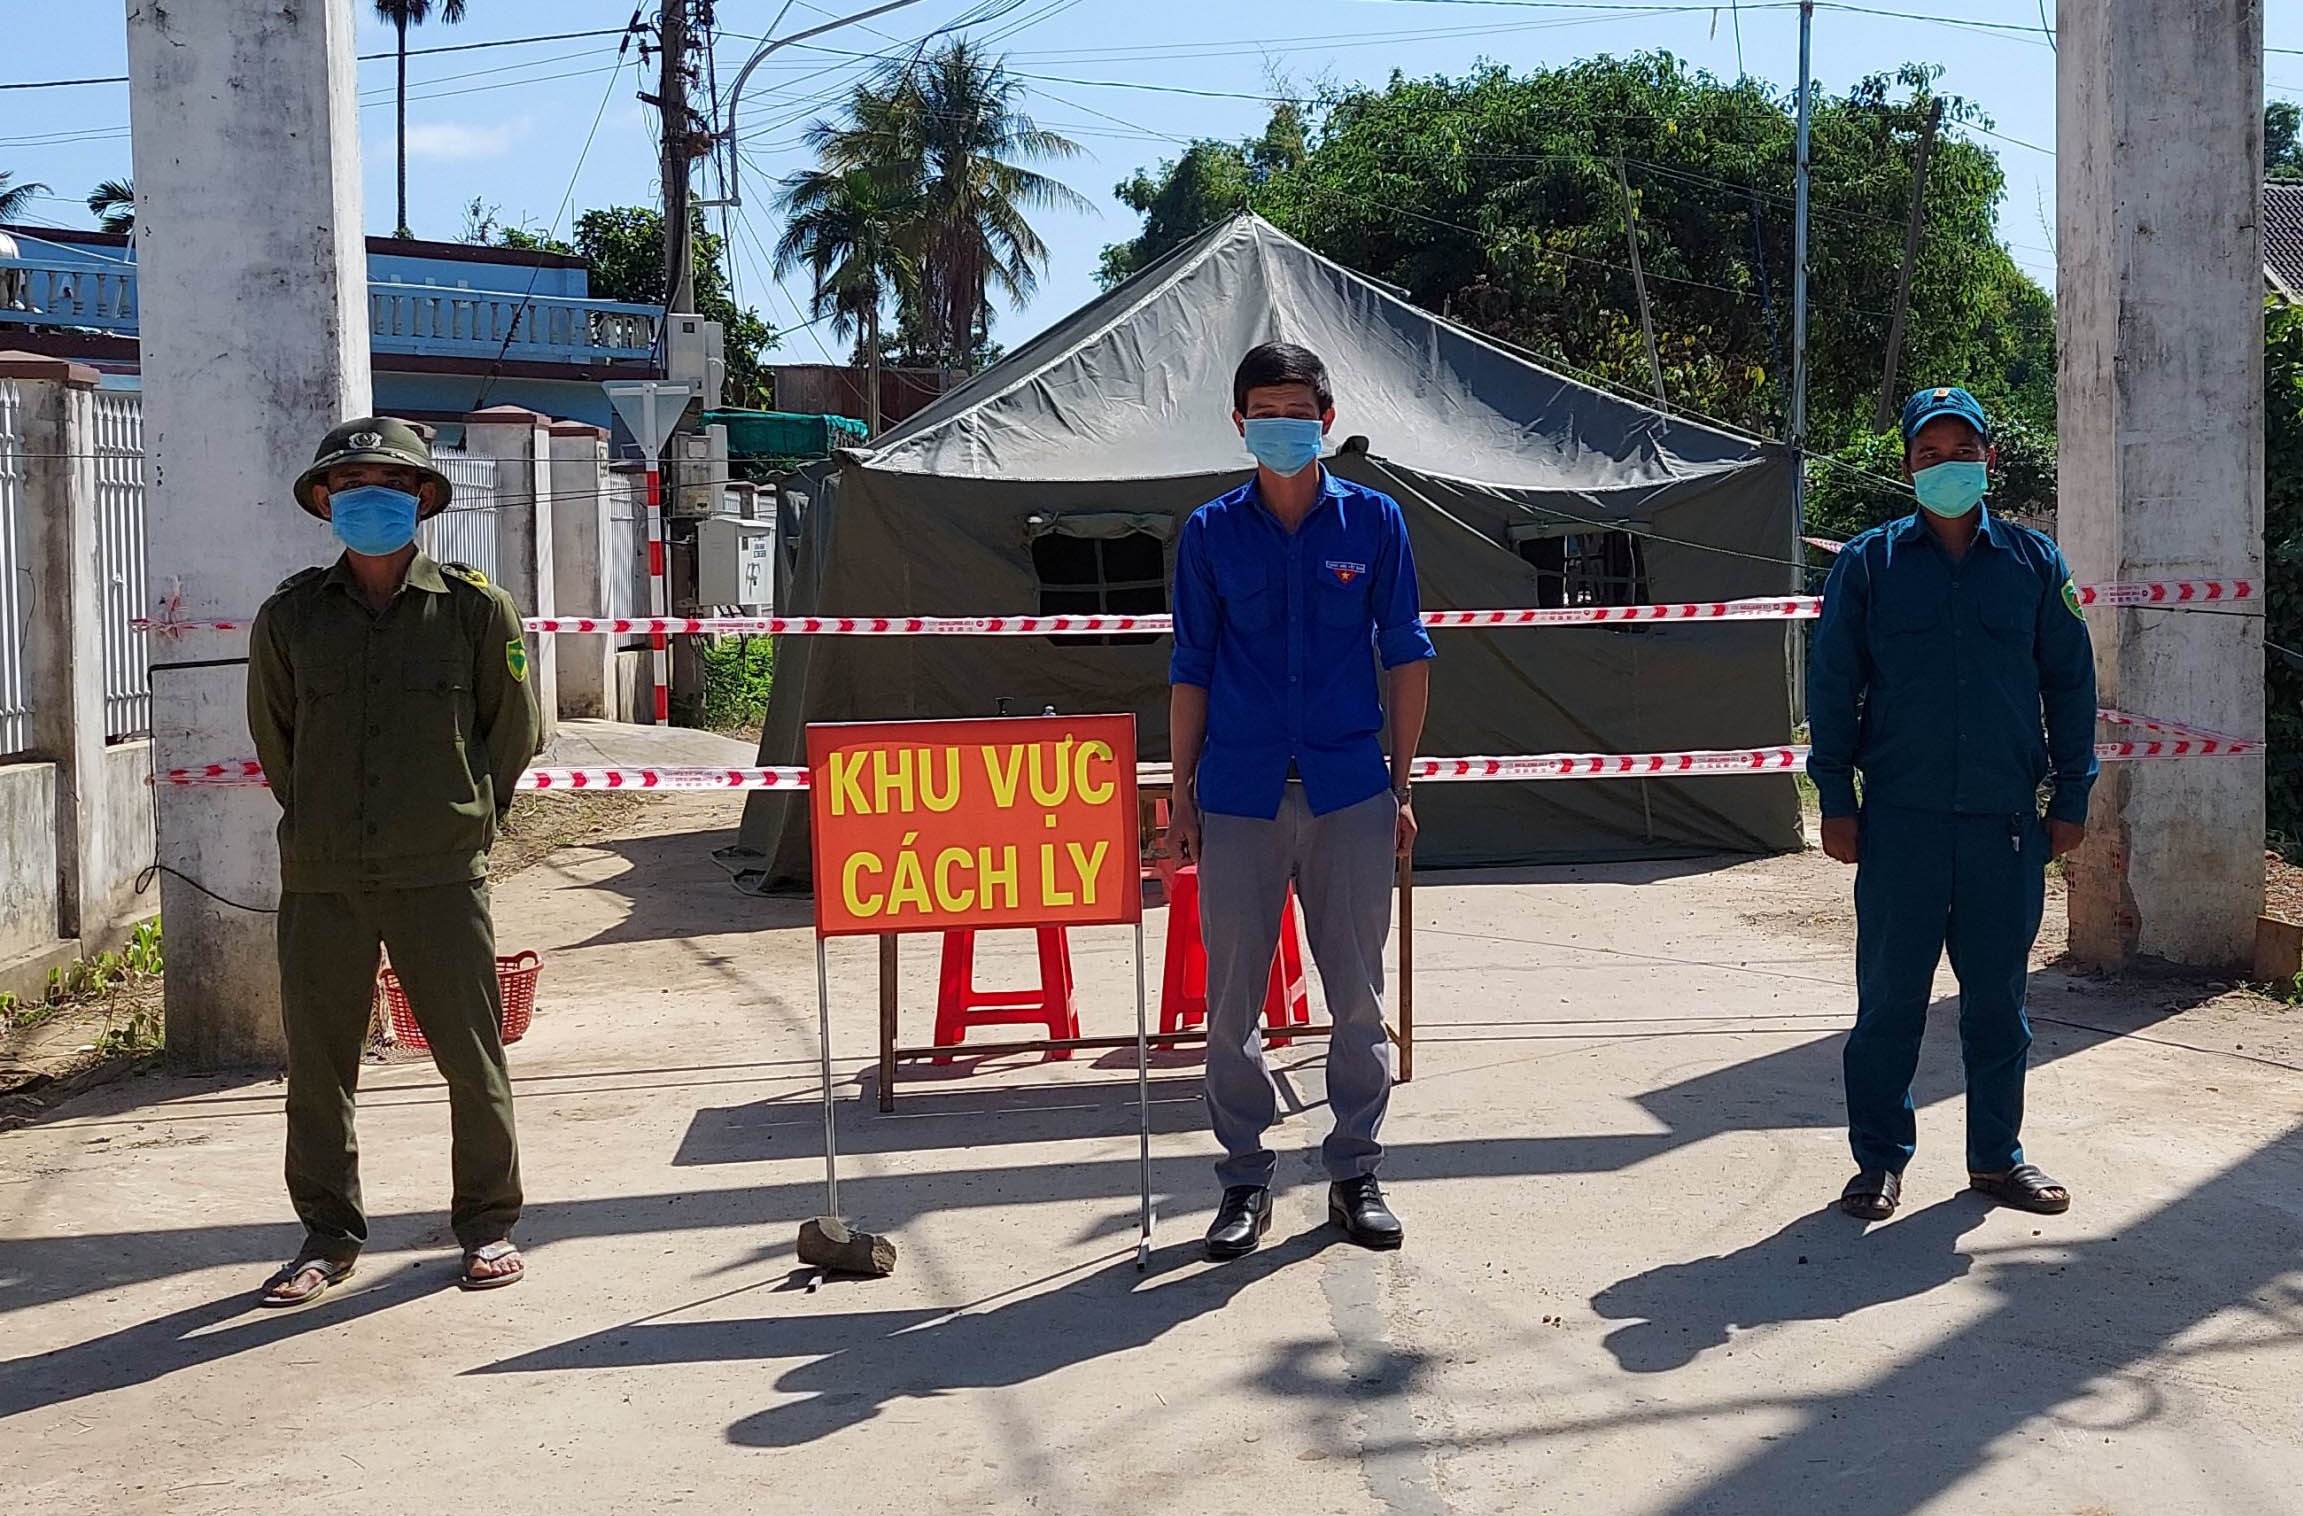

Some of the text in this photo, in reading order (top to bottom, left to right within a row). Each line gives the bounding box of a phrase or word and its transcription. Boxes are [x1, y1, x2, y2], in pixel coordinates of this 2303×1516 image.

[829, 732, 1115, 828] KHU VỰC
[842, 831, 1110, 917] CÁCH LY
